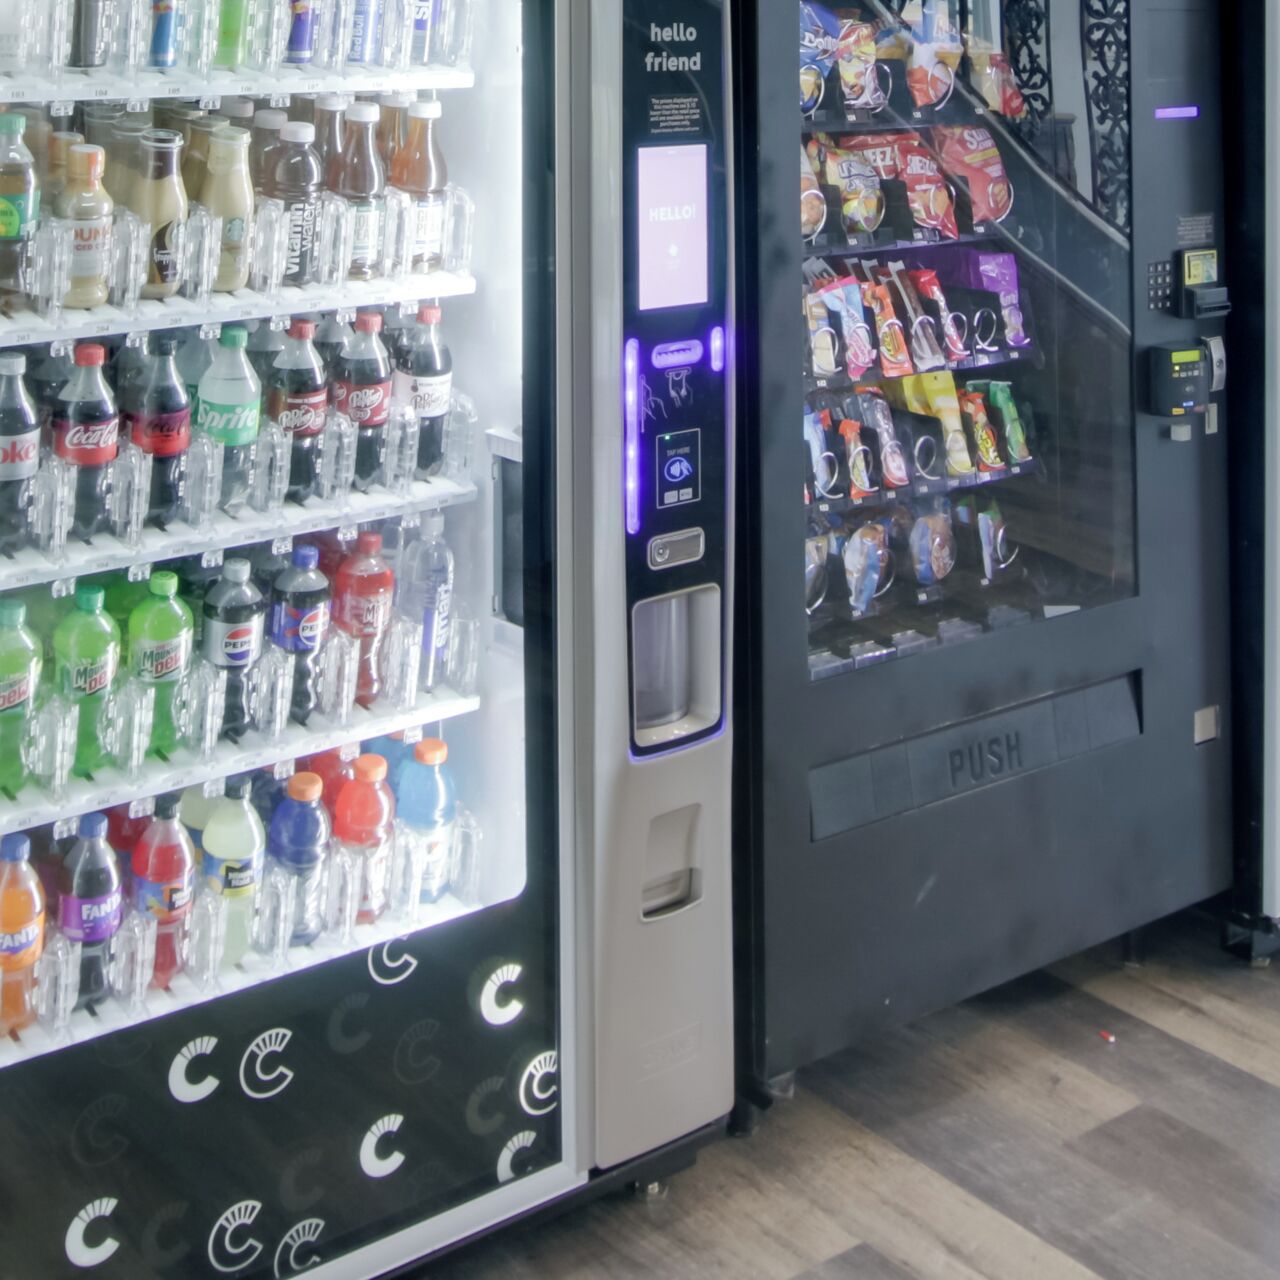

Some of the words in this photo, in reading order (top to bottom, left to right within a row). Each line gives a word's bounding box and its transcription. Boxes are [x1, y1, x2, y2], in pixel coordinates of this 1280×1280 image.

[650, 22, 697, 42] hello
[644, 51, 701, 72] friend
[302, 202, 315, 252] water
[648, 203, 696, 222] HELLO!
[285, 202, 304, 276] vitamin
[199, 405, 257, 430] Sprite
[436, 584, 452, 649] smart
[948, 730, 1024, 788] PUSH
